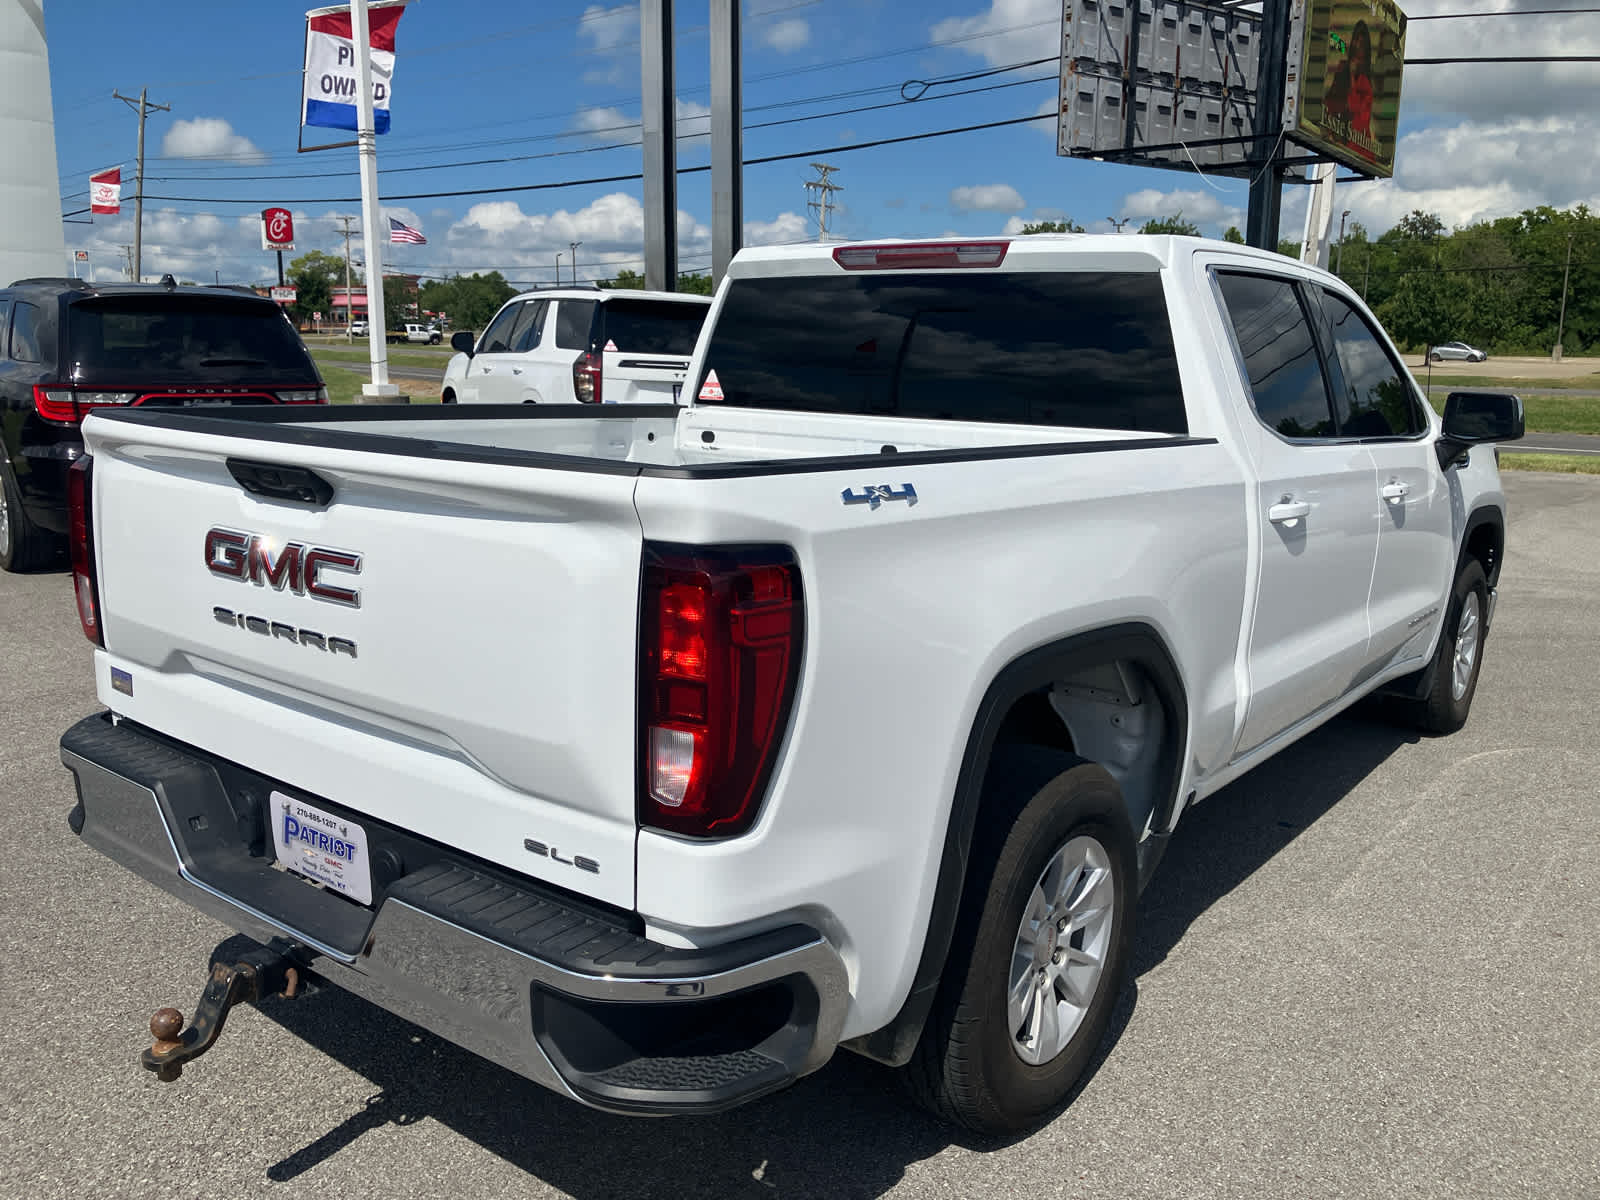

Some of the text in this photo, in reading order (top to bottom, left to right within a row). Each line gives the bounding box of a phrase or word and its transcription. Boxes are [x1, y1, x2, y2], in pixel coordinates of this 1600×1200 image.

[204, 526, 362, 610] GMC
[213, 606, 358, 659] SIERRA
[283, 815, 356, 862] PATRIOT
[523, 838, 600, 875] SLE
[324, 857, 343, 870] GMC
